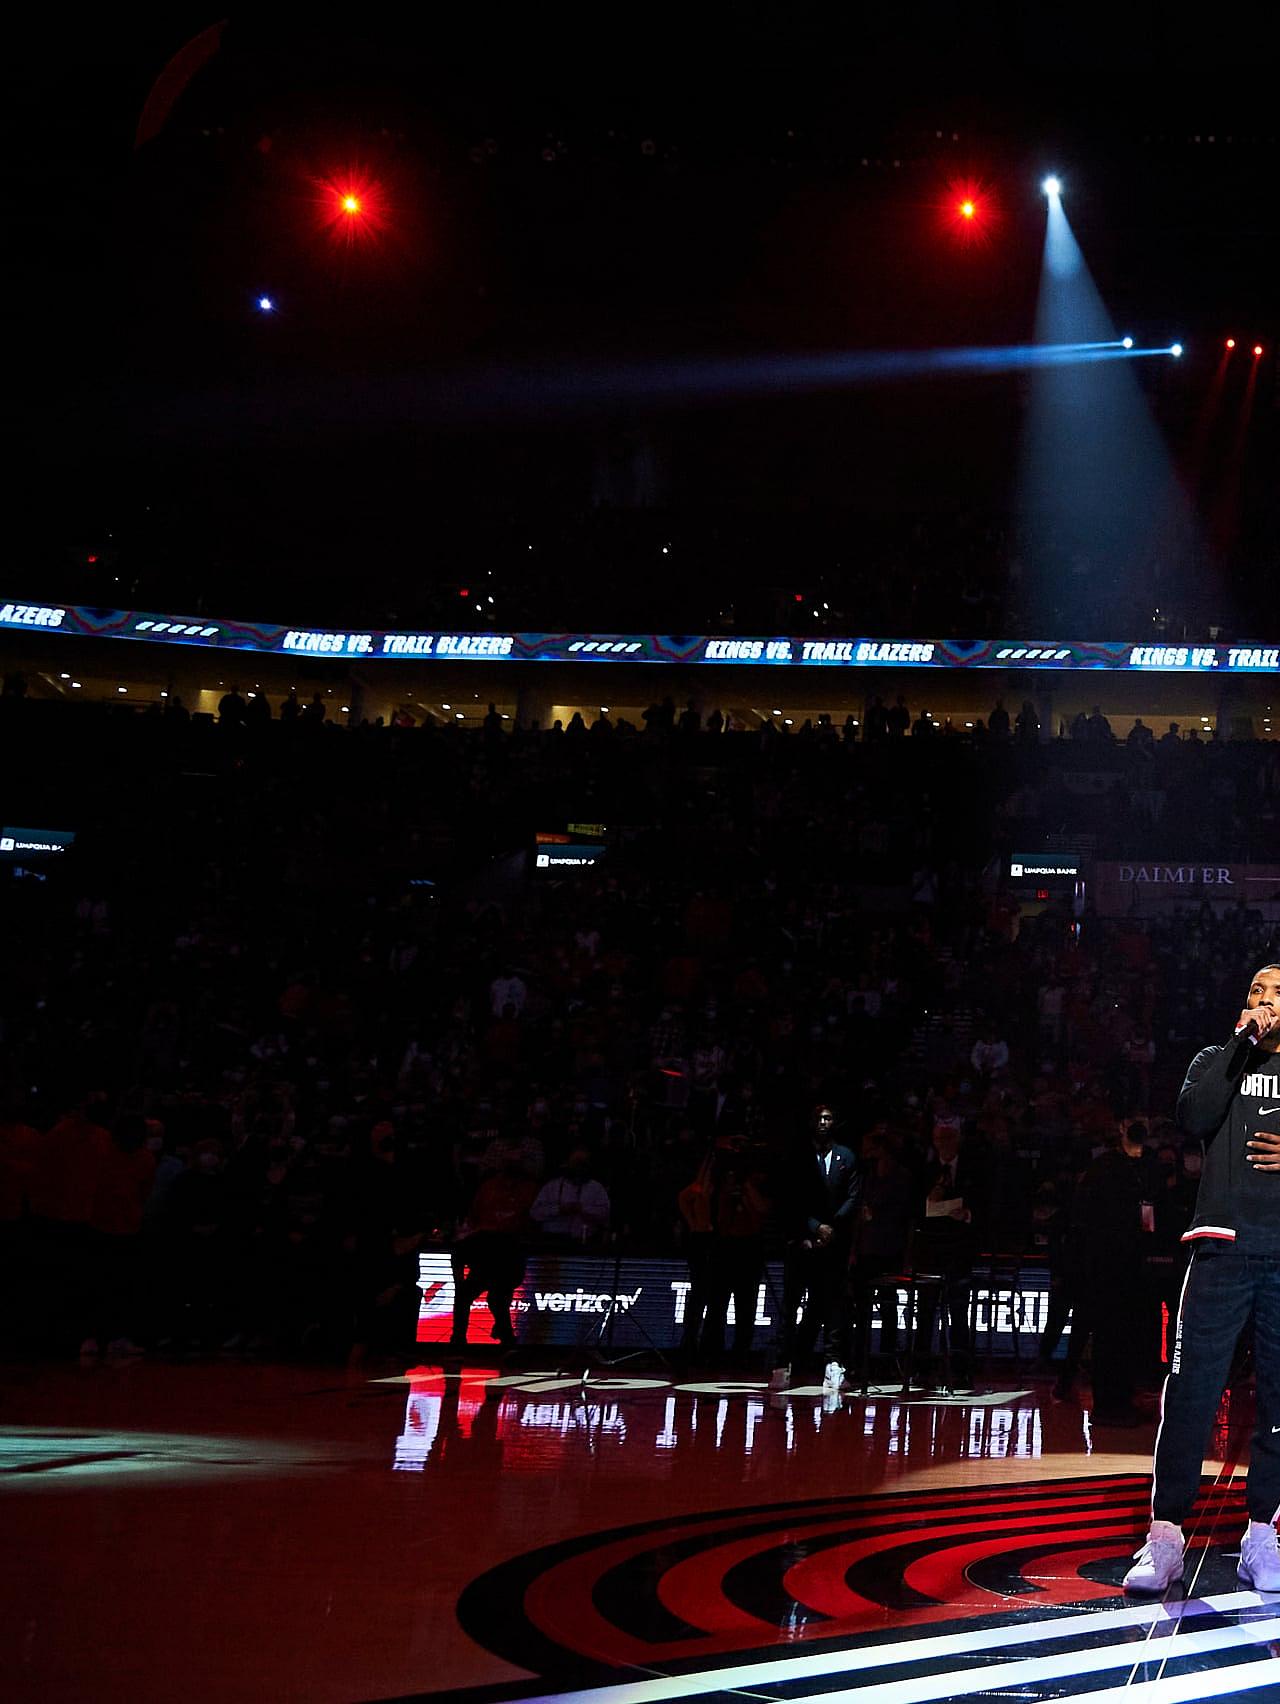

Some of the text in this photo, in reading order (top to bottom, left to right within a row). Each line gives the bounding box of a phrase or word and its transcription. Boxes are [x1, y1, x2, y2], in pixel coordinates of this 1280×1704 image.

[283, 631, 514, 655] KINGS VS. TRAIL BLAZERS
[705, 641, 935, 662] KINGS VS. TRAIL BLAZERS
[1129, 648, 1189, 666] KINGS
[1191, 649, 1219, 667] VS.
[1228, 649, 1280, 667] TRAIL
